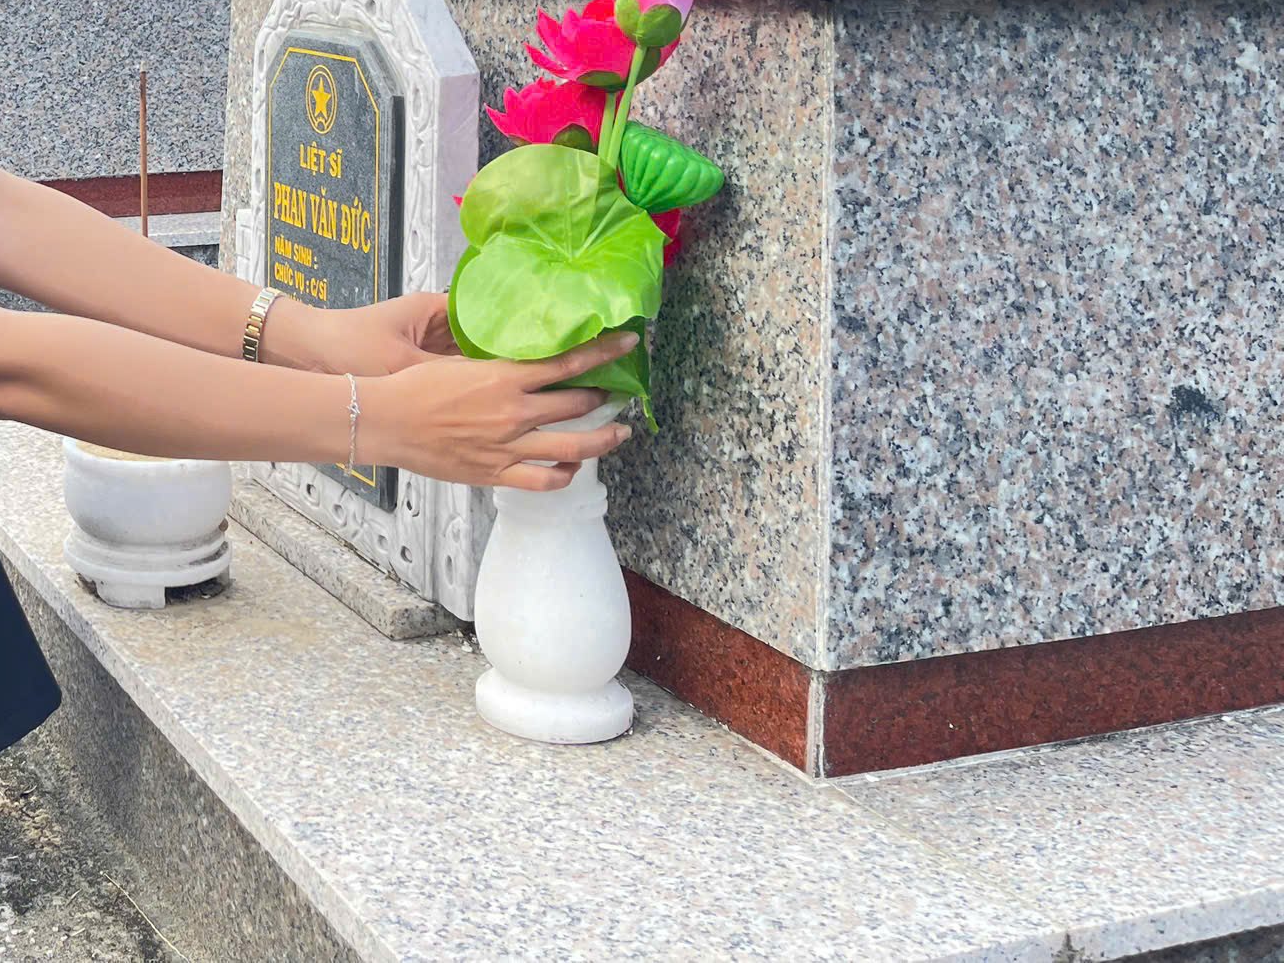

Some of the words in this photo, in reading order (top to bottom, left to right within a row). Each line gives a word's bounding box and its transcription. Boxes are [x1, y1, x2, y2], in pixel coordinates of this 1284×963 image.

[299, 141, 326, 176] LIỆT
[329, 148, 343, 179] SĨ
[273, 181, 307, 230] PHAN
[309, 186, 338, 241] VĂN
[340, 196, 372, 254] ĐỨC
[274, 234, 292, 260] NĂM
[293, 243, 313, 269] SINH
[274, 262, 294, 287] CHỨC
[294, 269, 305, 295] VỤ
